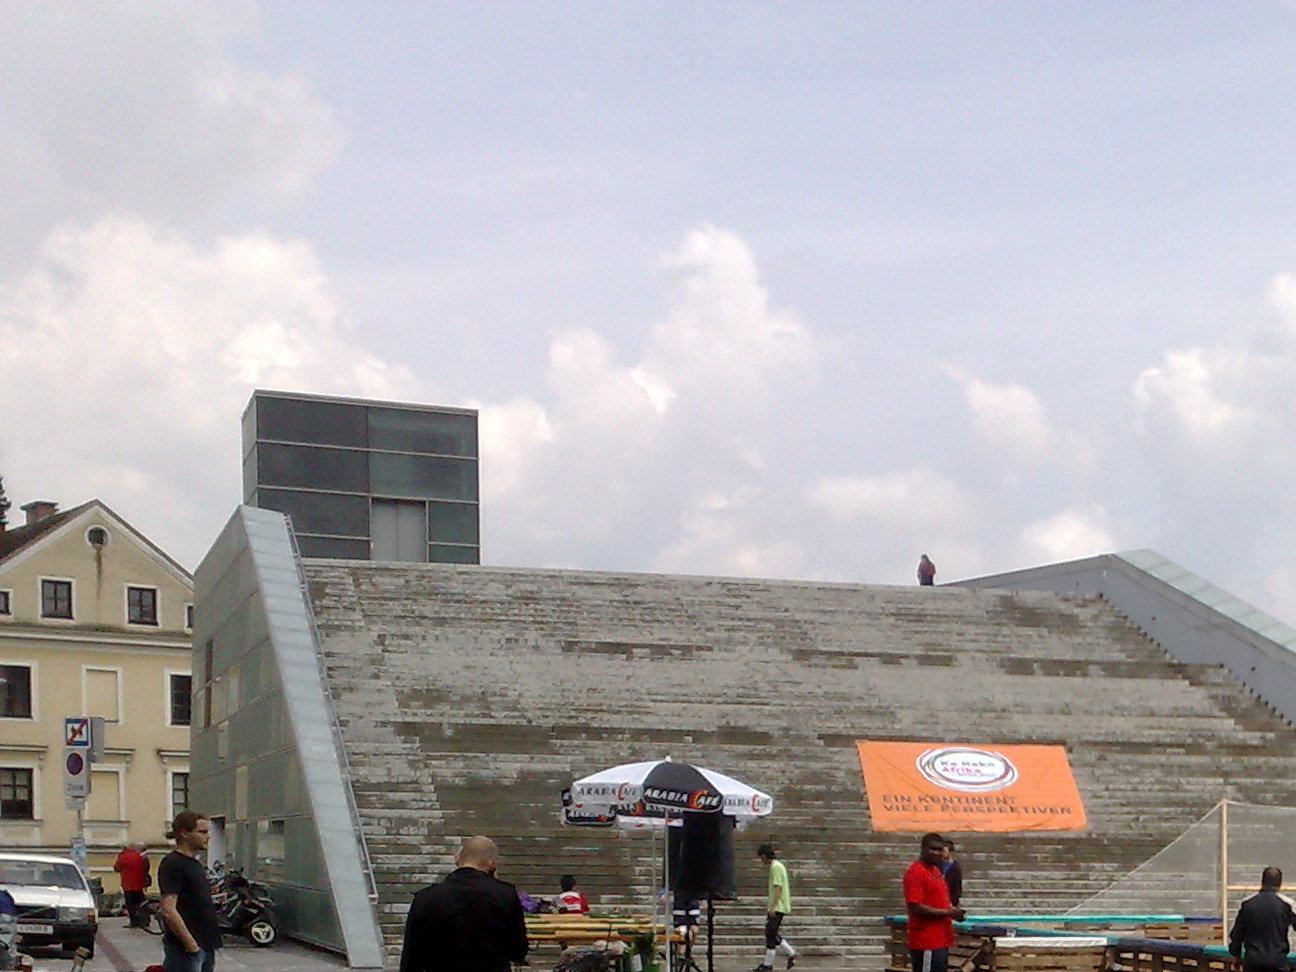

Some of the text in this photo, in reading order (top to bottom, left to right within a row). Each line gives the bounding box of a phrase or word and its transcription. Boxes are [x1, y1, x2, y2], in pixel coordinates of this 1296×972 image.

[579, 787, 616, 796] ARABIA
[643, 788, 688, 803] ARABIA
[881, 795, 1016, 805] EIN KONTINENT
[882, 804, 934, 812] VIELE
